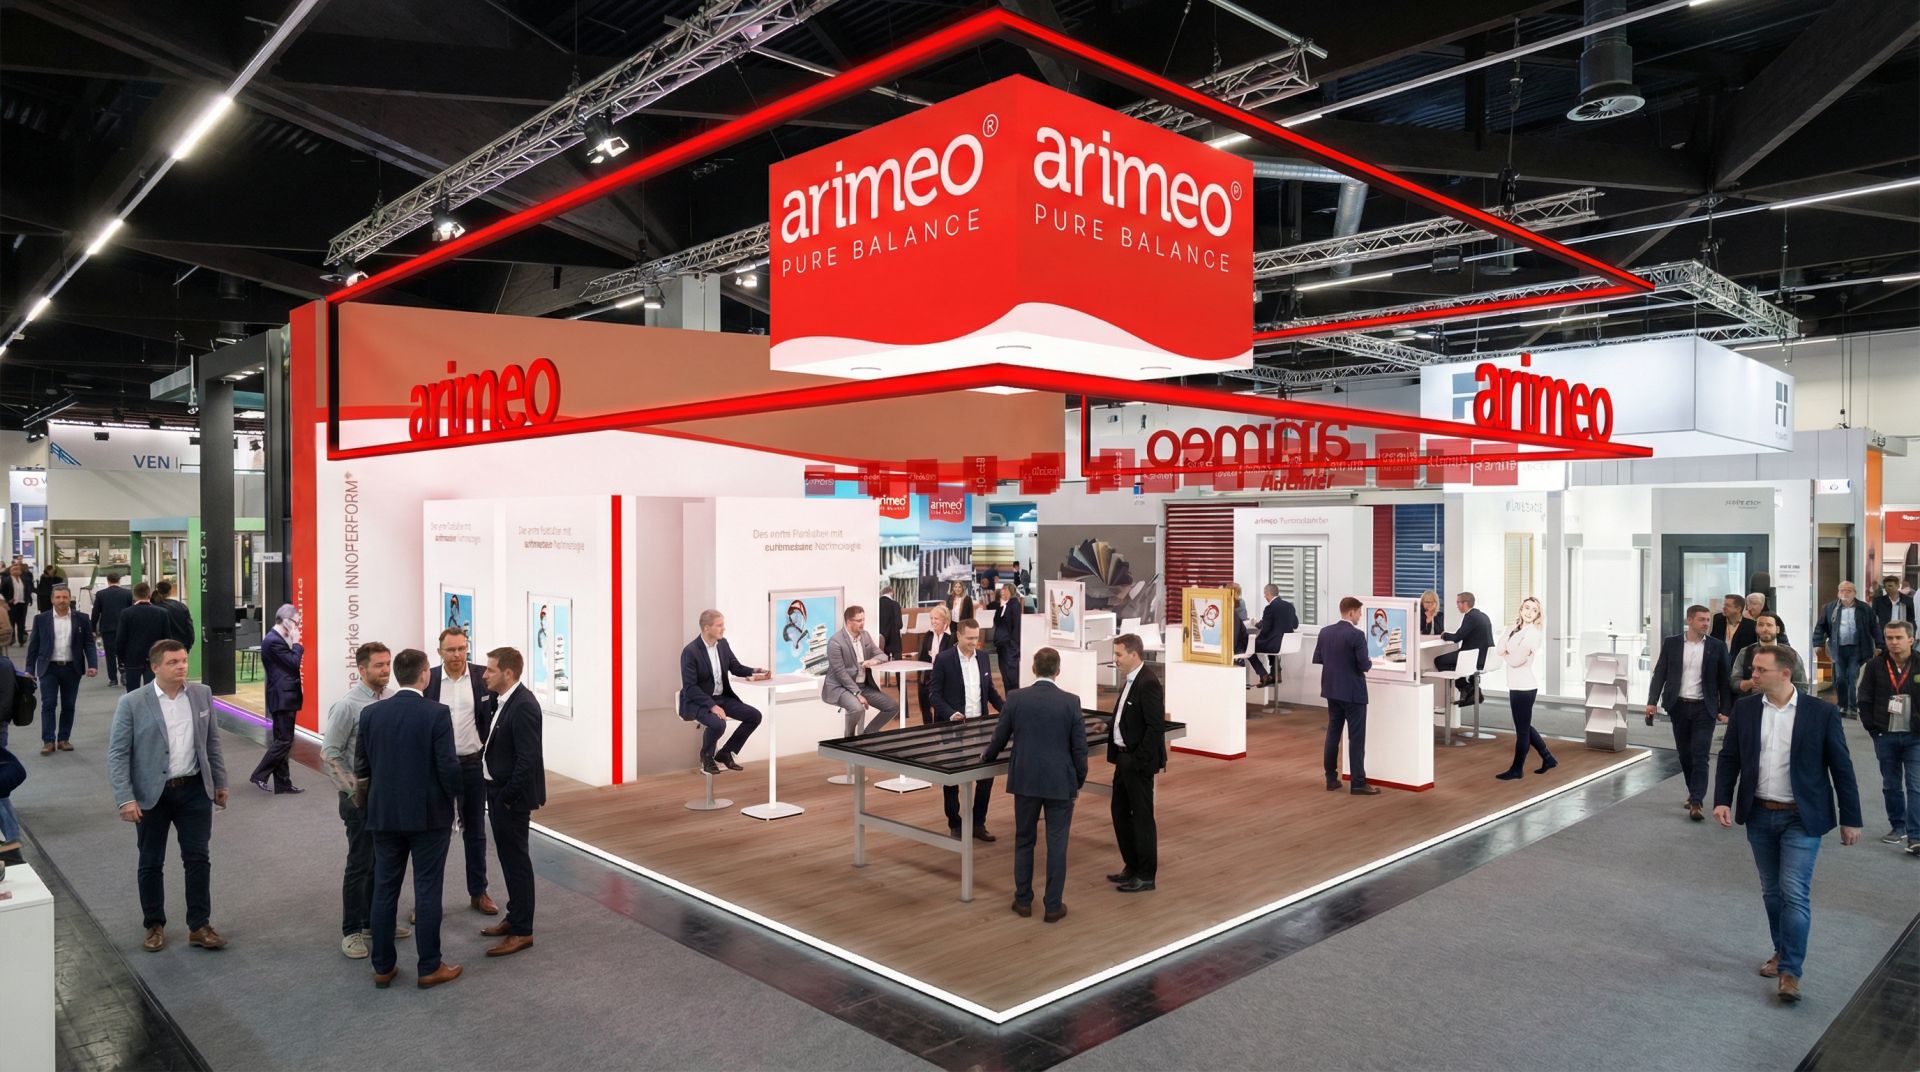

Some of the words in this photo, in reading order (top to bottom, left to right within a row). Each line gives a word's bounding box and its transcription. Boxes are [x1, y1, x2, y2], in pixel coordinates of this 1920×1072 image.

[782, 246, 838, 278] PURE
[853, 208, 980, 260] BALANCE
[1035, 203, 1104, 241] PURE
[1121, 226, 1230, 273] BALANCE
[409, 357, 561, 442] arimeo
[1473, 352, 1614, 443] arimeo
[349, 594, 359, 620] von
